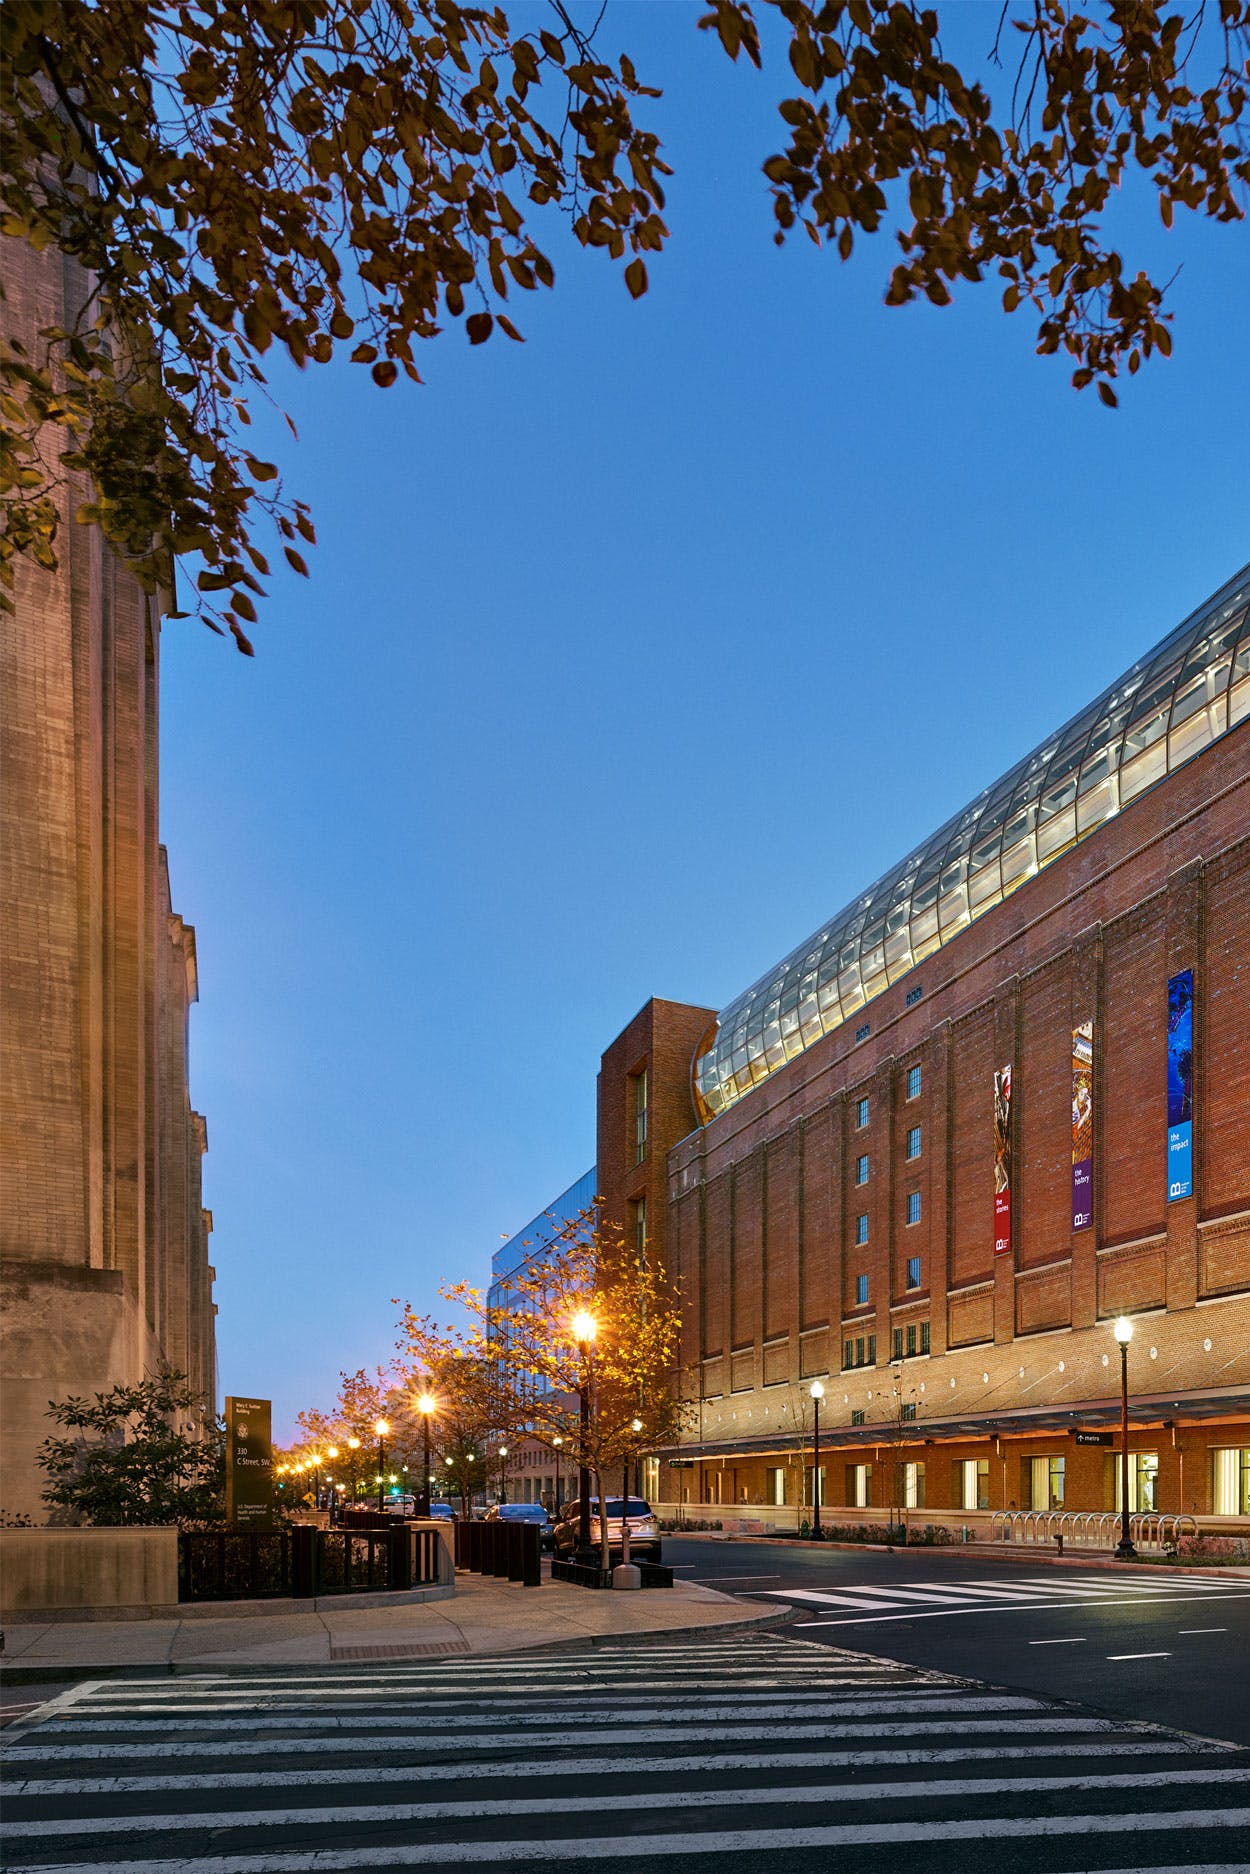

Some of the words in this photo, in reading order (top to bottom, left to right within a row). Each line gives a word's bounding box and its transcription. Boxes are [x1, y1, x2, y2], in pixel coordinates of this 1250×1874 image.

[1171, 1133, 1180, 1142] the
[1171, 1139, 1189, 1151] impact
[1075, 1176, 1089, 1186] history
[237, 1447, 248, 1455] 330
